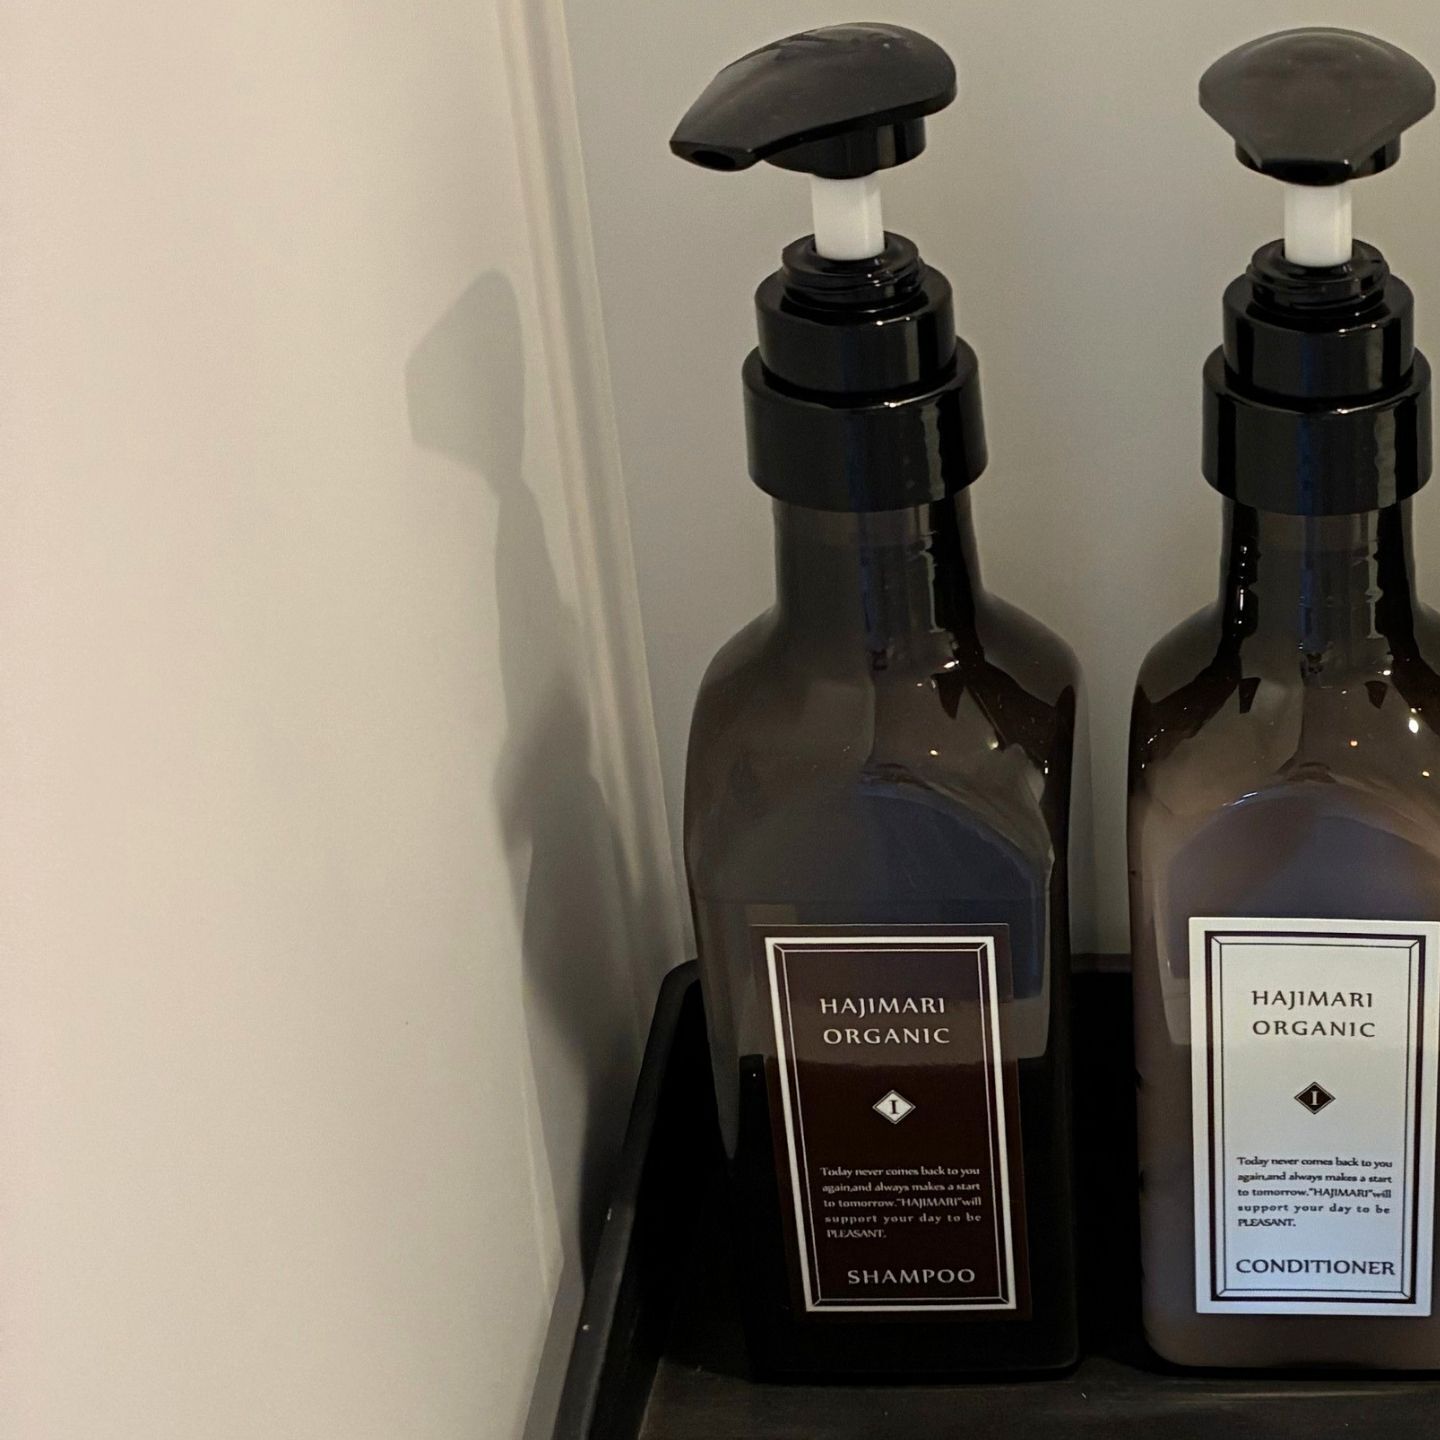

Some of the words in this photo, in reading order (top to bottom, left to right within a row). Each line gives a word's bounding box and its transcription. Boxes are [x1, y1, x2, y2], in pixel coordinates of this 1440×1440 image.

[1251, 990, 1373, 1011] HAJIMARI
[820, 998, 946, 1018] HAJIMARI
[823, 1028, 950, 1044] ORGANIC
[1252, 1020, 1376, 1038] ORGANIC
[1237, 1156, 1269, 1167] Today
[1336, 1157, 1359, 1166] back
[1374, 1160, 1392, 1169] you
[820, 1166, 852, 1178] Today
[921, 1166, 945, 1175] back
[960, 1169, 980, 1178] you
[1289, 1172, 1322, 1183] always
[1325, 1173, 1357, 1182] makes
[1368, 1175, 1392, 1183] start
[874, 1181, 910, 1193] always
[912, 1181, 945, 1190] makes
[1237, 1204, 1289, 1213] support
[1294, 1205, 1324, 1213] your
[1329, 1203, 1352, 1214] day
[1375, 1205, 1390, 1214] be
[825, 1215, 877, 1224] support
[884, 1215, 914, 1224] your
[919, 1213, 942, 1224] day
[966, 1212, 982, 1222] be
[1235, 1258, 1395, 1275] CONDITIONER
[848, 1269, 976, 1284] SHAMPOO
